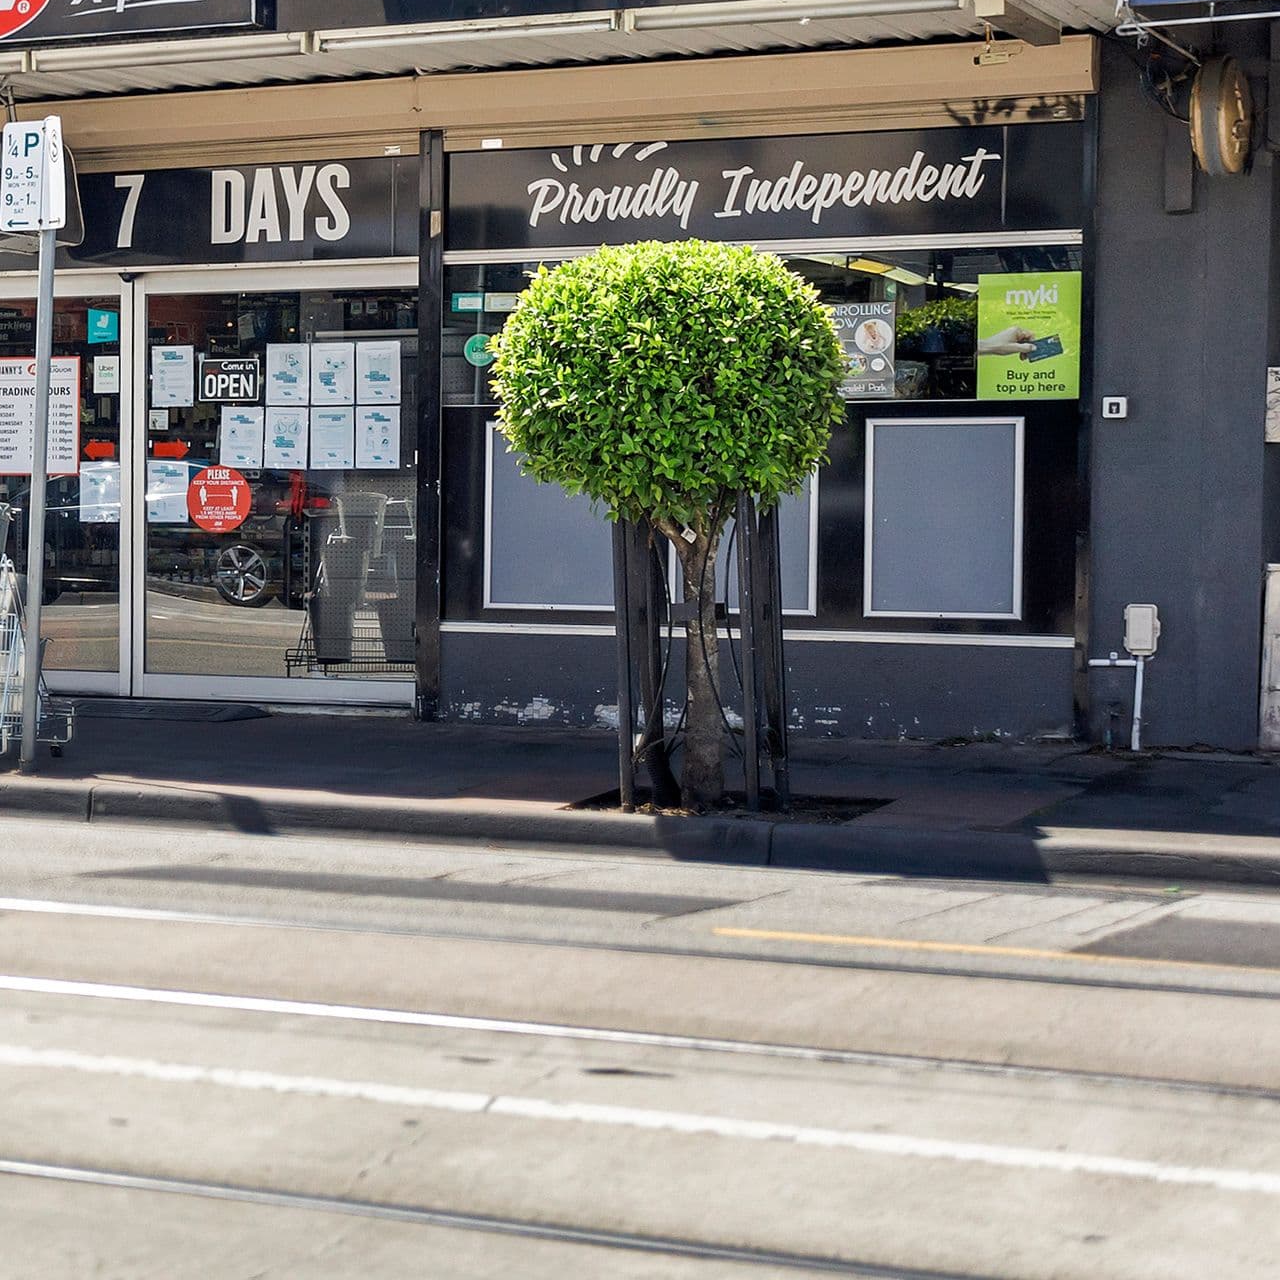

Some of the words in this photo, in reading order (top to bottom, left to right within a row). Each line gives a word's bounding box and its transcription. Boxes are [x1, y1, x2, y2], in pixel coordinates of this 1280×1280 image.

[24, 132, 40, 158] P
[527, 168, 700, 229] Proudly
[714, 147, 1002, 224] Independent
[115, 173, 145, 249] 7
[211, 163, 351, 245] DAYS
[1005, 283, 1059, 310] myki
[833, 304, 892, 316] NROLLING
[835, 318, 858, 329] OW
[221, 361, 243, 371] Come
[245, 361, 255, 370] in
[1006, 370, 1030, 381] Buy
[1033, 369, 1056, 379] and
[48, 386, 71, 396] OURS
[205, 374, 254, 398] OPEN
[996, 383, 1017, 394] top
[1020, 383, 1035, 394] up
[1038, 382, 1066, 392] here
[207, 469, 231, 480] PLEASE
